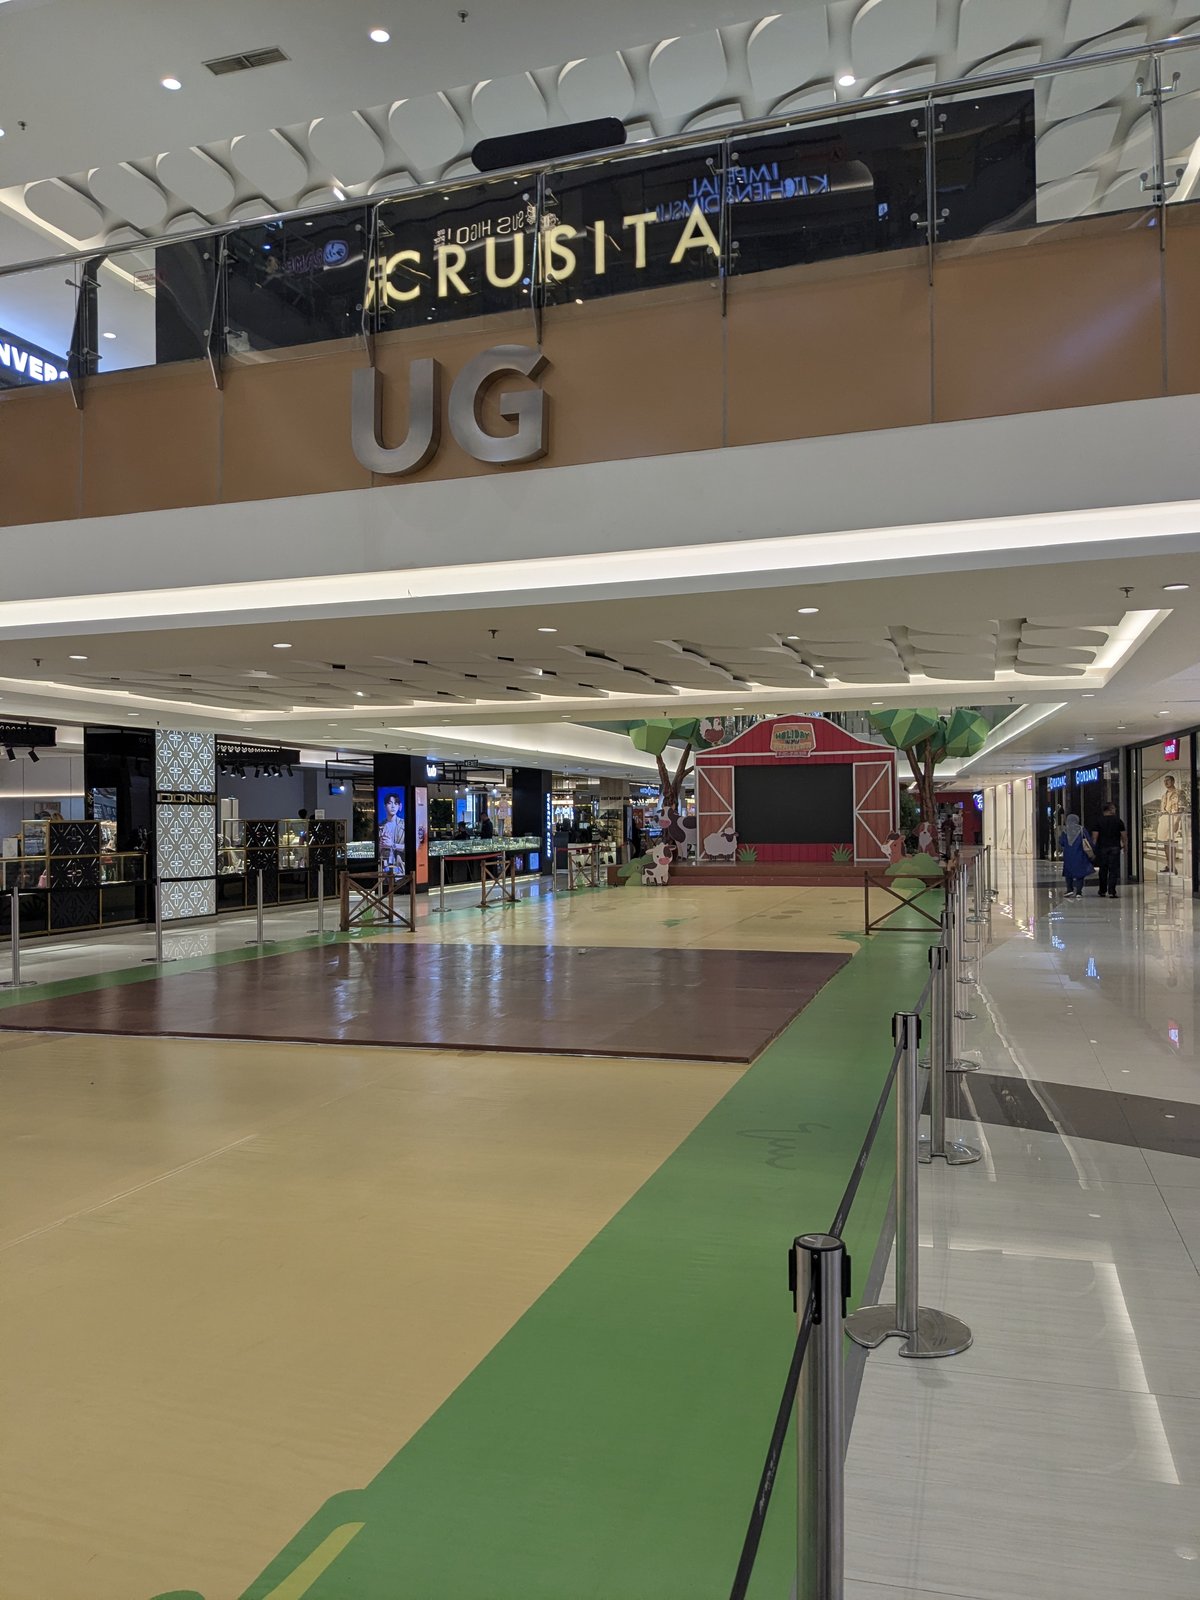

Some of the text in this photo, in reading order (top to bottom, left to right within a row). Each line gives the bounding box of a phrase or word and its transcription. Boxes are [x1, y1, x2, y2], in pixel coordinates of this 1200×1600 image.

[386, 207, 721, 301] CRUSITA
[351, 345, 552, 476] UG
[775, 730, 810, 739] HOLIDAY
